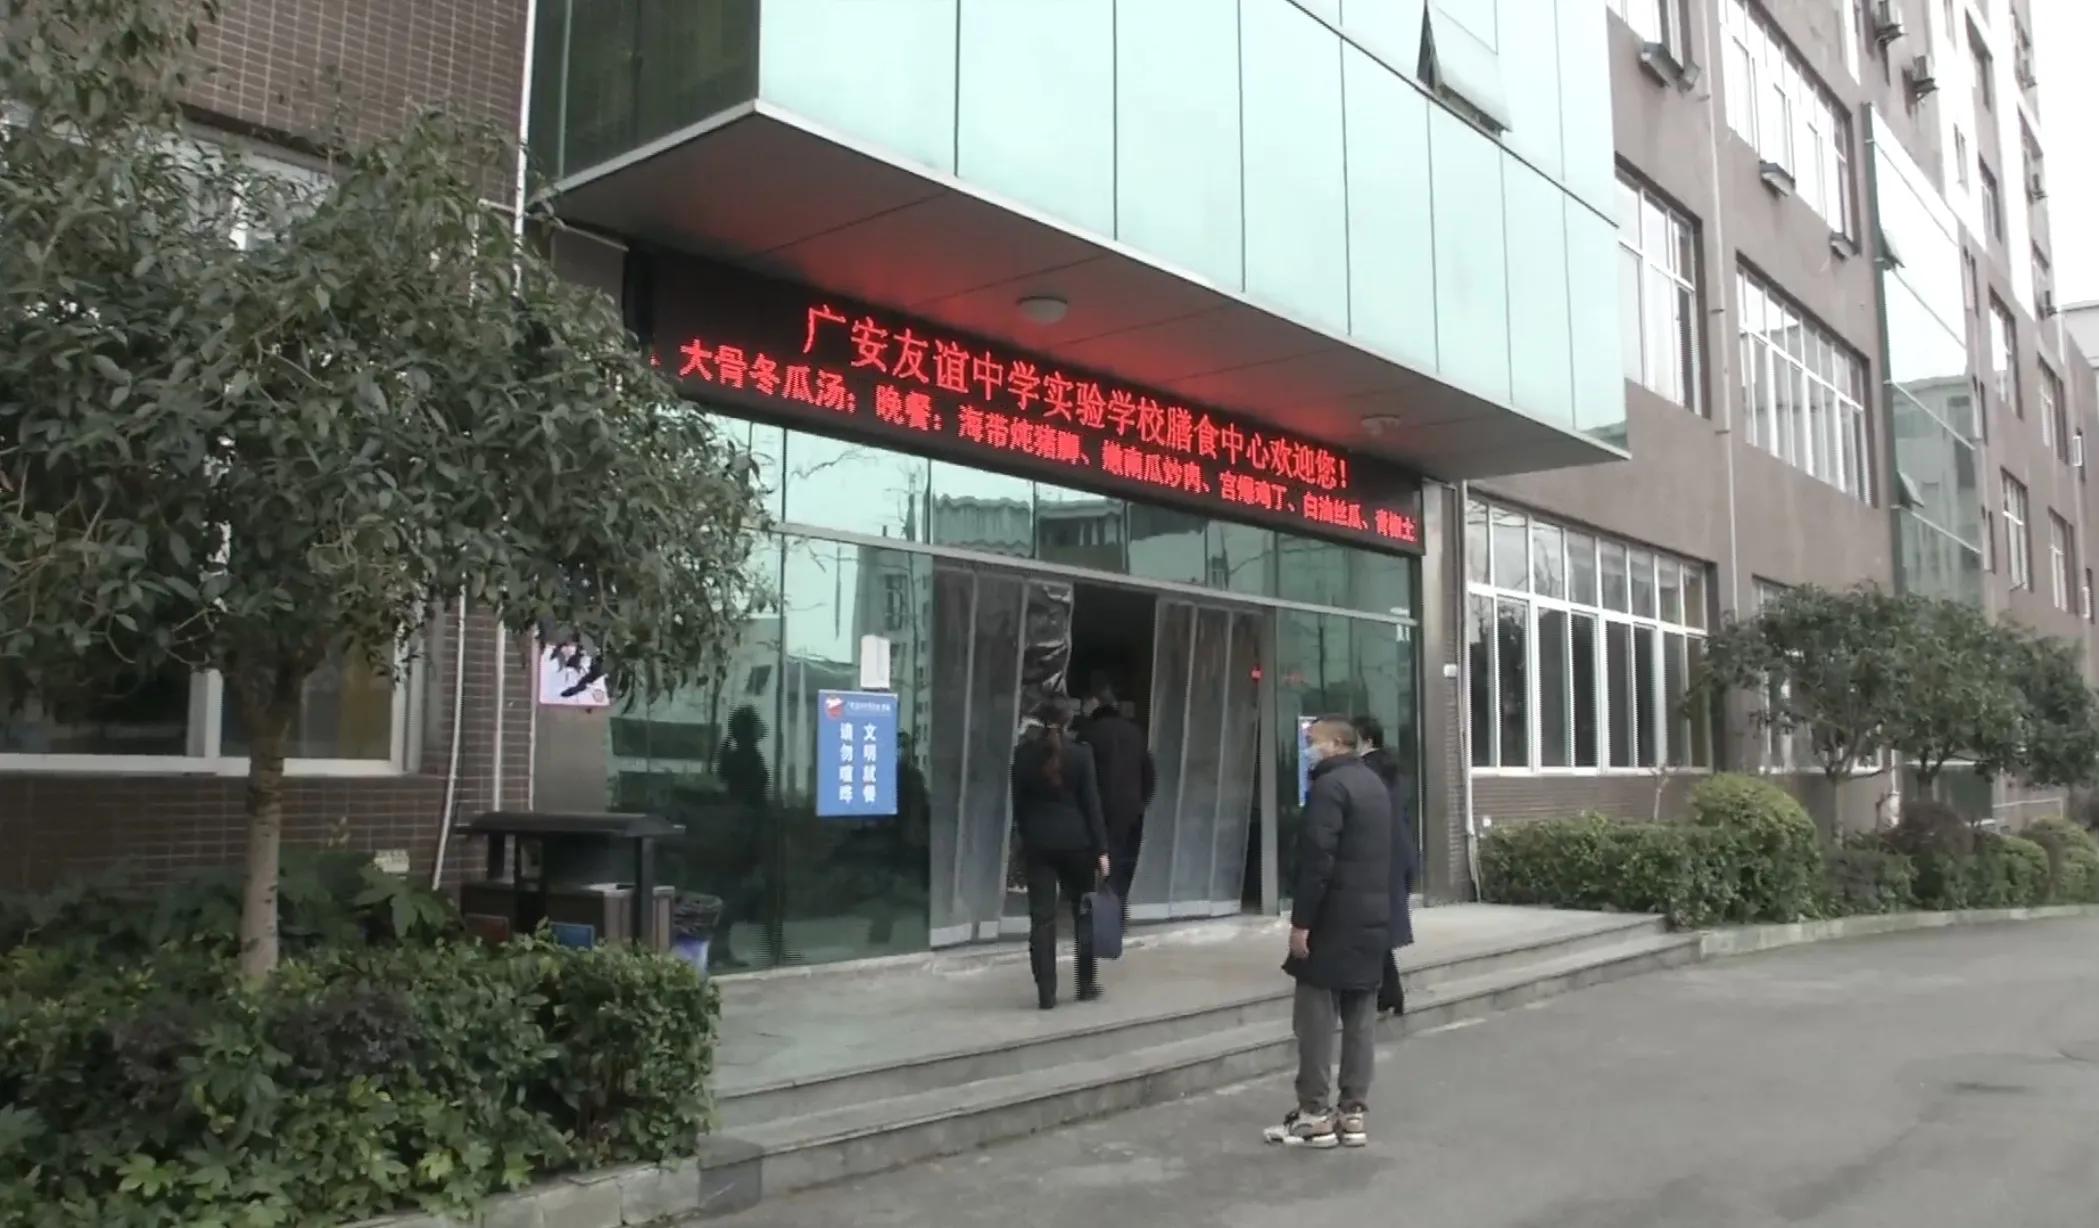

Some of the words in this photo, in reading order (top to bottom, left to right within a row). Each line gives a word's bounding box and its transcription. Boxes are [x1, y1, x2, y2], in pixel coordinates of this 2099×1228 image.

[839, 722, 852, 804] 请勿喧哗
[863, 722, 876, 803] 文明就餐
